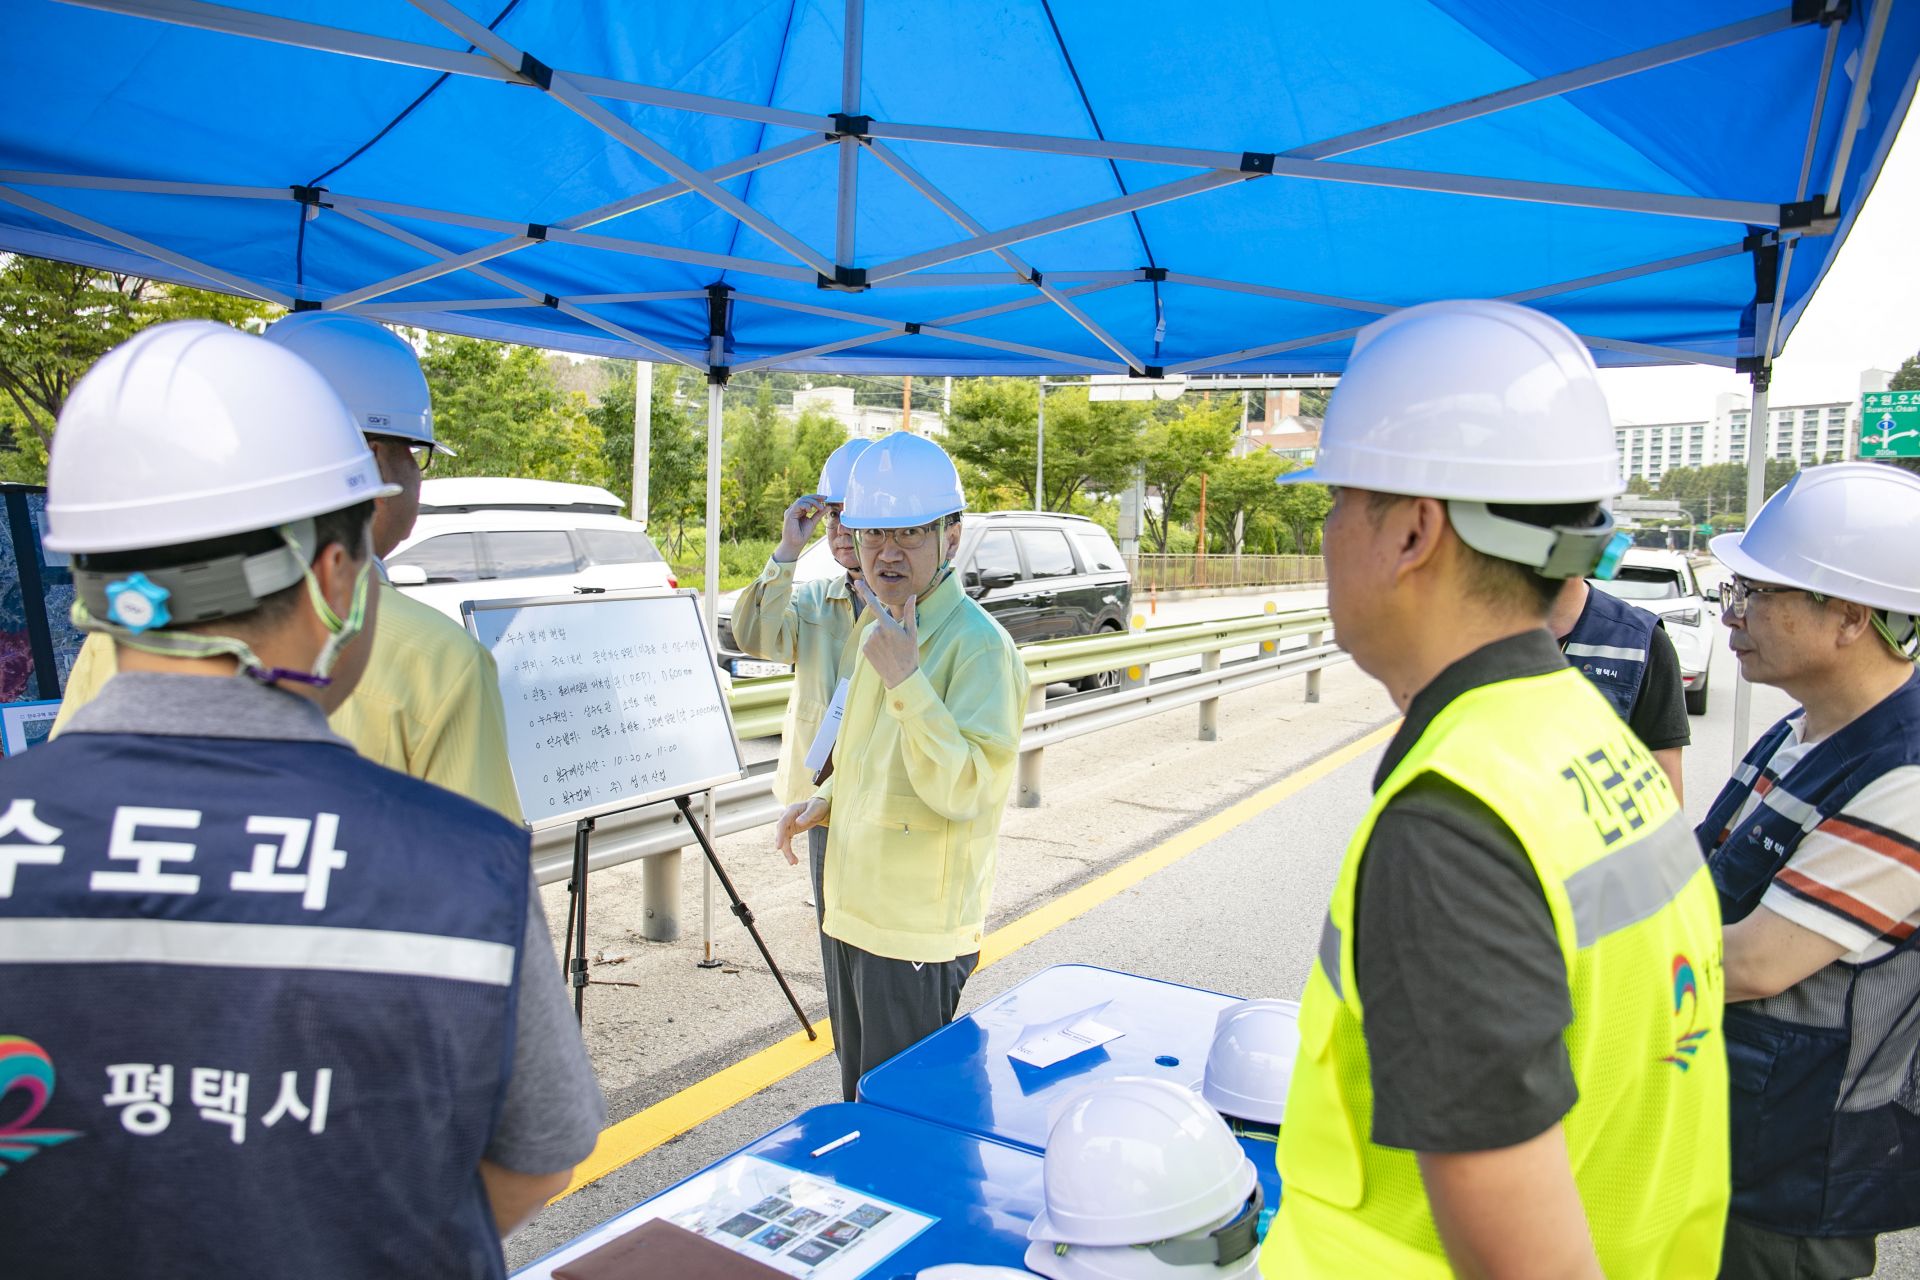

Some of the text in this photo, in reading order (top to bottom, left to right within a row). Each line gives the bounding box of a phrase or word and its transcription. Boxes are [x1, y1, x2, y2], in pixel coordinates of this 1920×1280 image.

[506, 627, 566, 646] 누수 발생 현황
[1595, 667, 1618, 678] 평택시
[615, 754, 641, 767] 10:20
[657, 744, 678, 757] 11:00
[103, 1063, 332, 1144] 평택시
